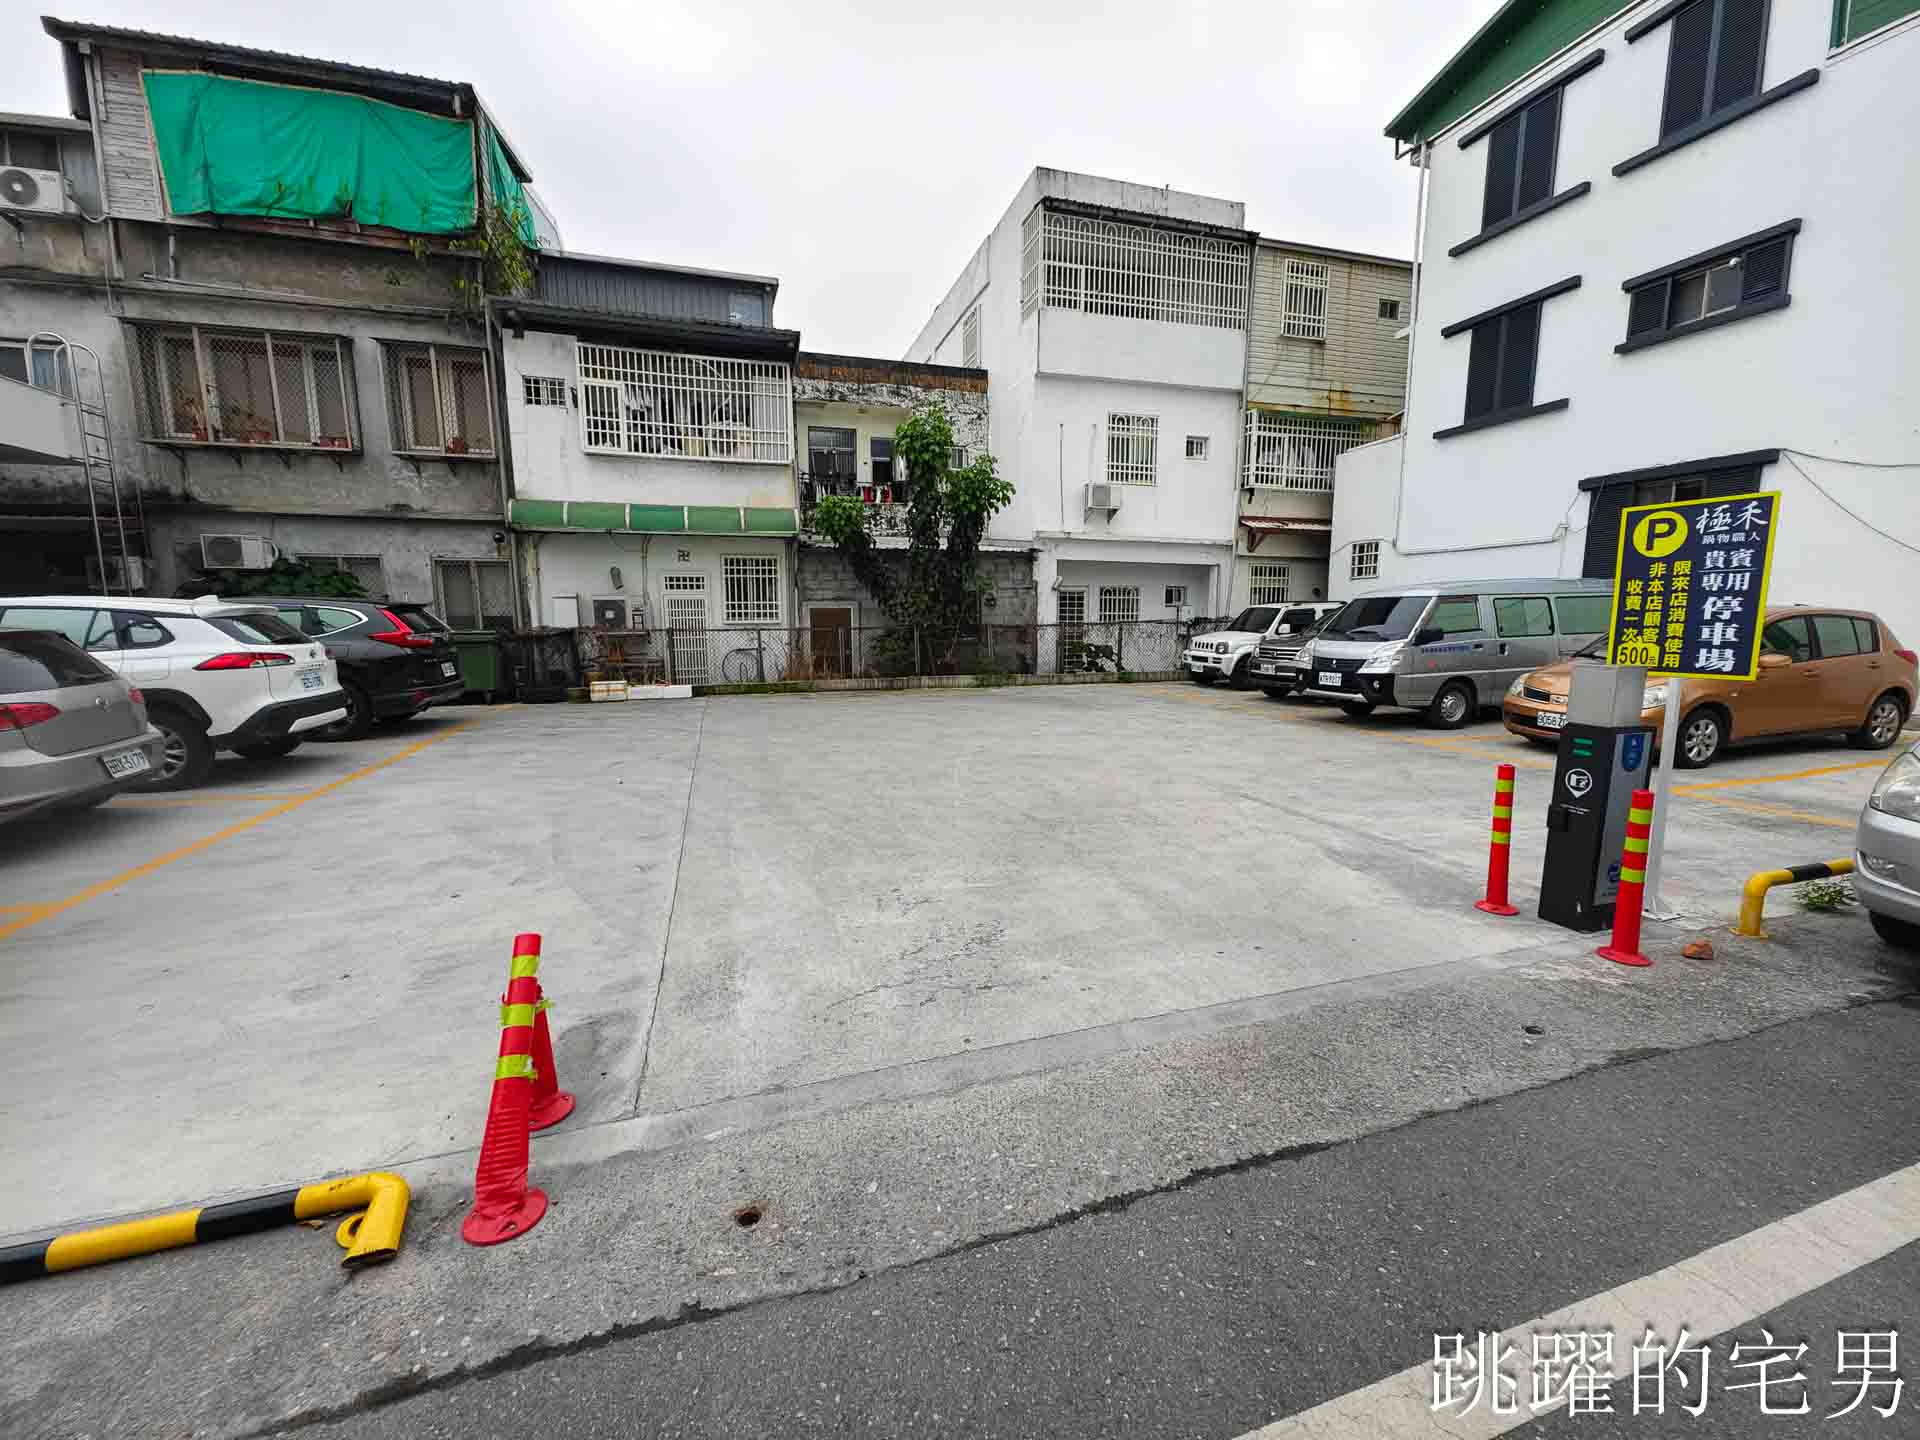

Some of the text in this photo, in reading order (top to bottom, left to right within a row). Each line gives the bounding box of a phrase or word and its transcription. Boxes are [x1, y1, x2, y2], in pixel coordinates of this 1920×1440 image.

[1645, 517, 1678, 551] P
[1703, 549, 1755, 569] 貴賓
[1622, 579, 1644, 643] 收費一次
[1642, 562, 1667, 643] 非本店顧客
[1701, 572, 1750, 591] 專用
[1662, 560, 1692, 668] 限來店消費使用
[1695, 596, 1745, 672] 停車場
